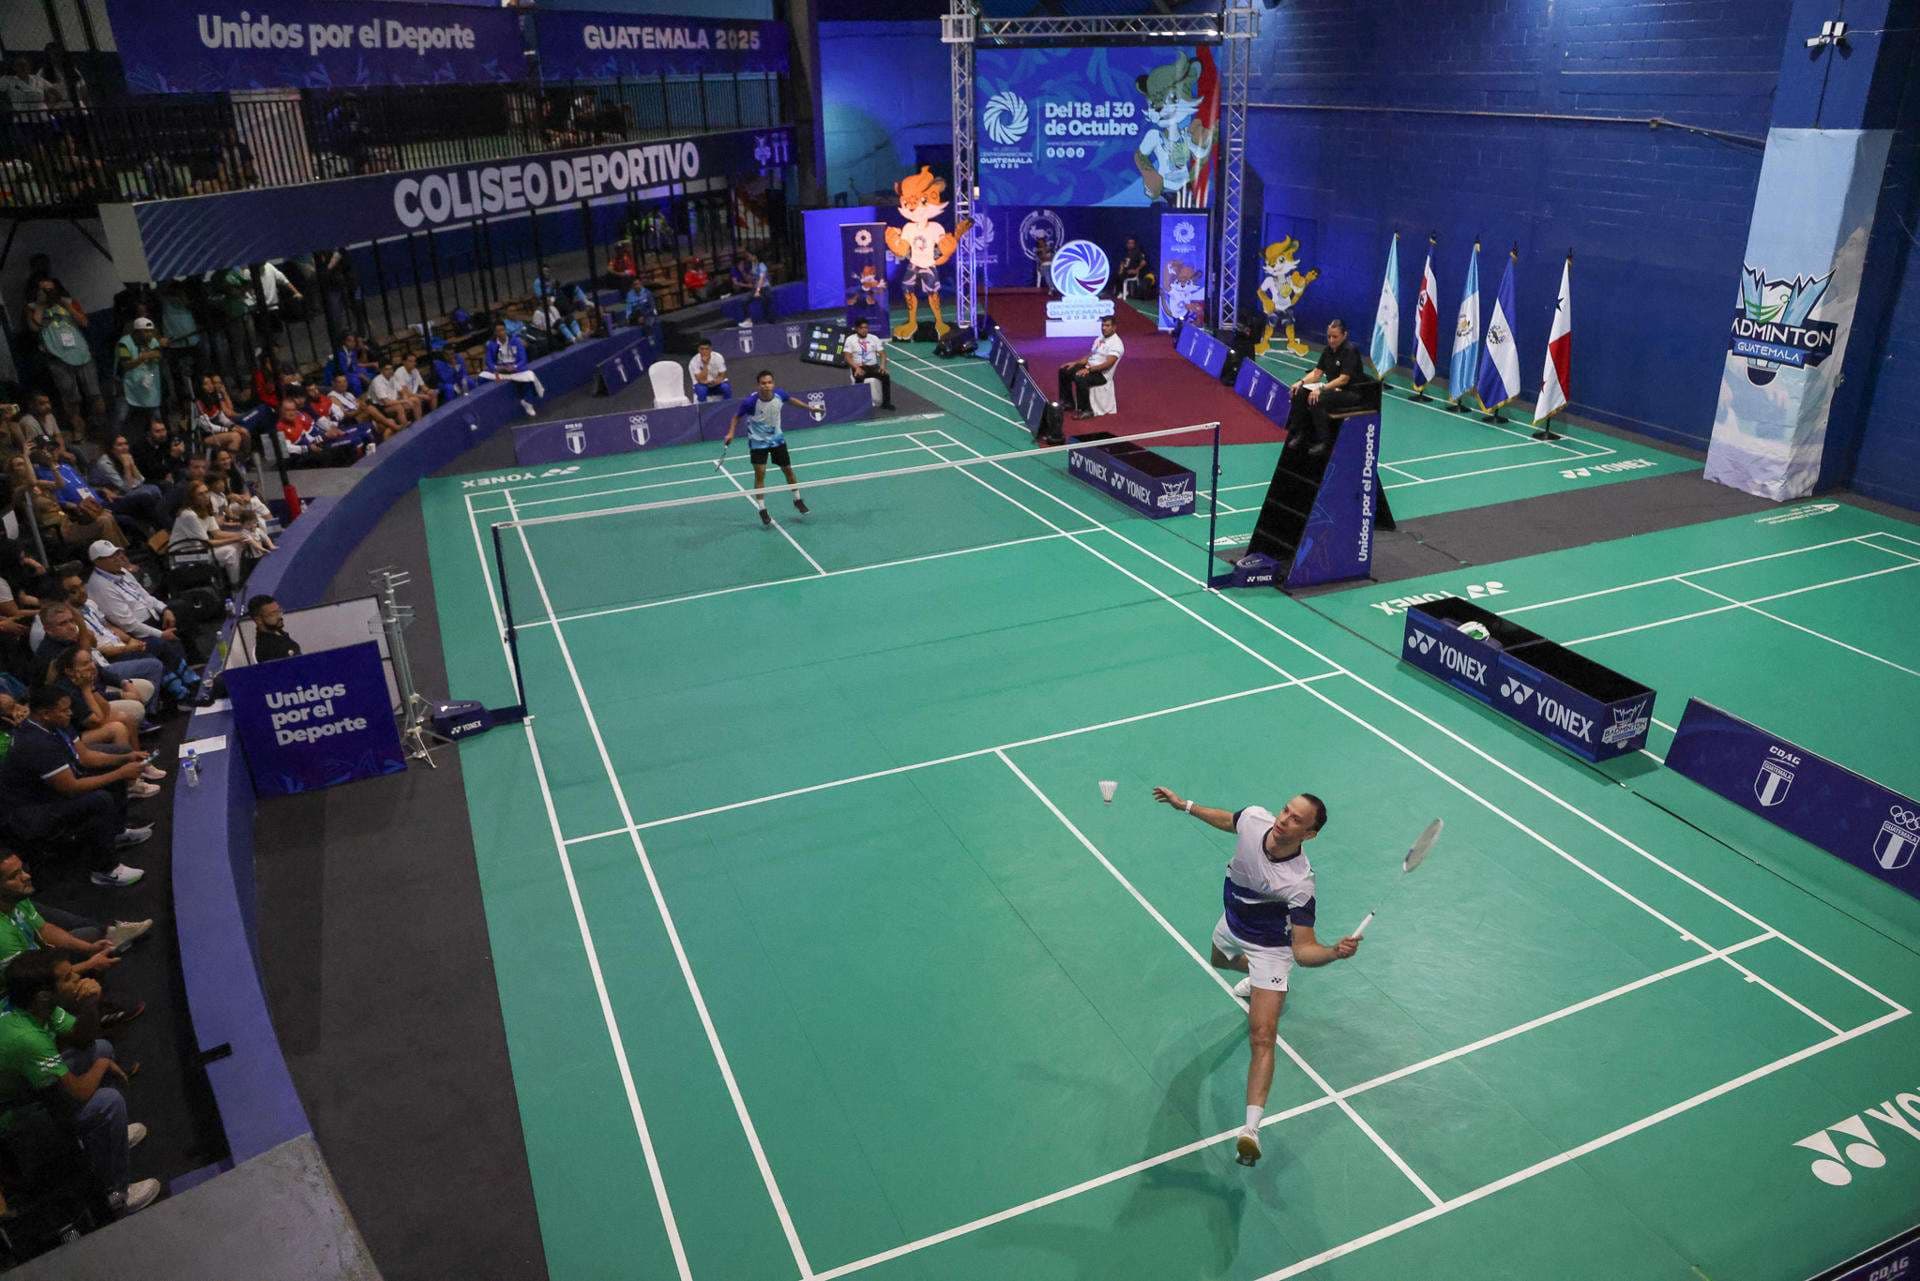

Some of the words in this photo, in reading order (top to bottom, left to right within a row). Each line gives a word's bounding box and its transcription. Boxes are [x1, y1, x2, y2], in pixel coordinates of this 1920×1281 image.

[199, 11, 303, 48] Unidos
[309, 23, 353, 55] por
[359, 19, 380, 47] el
[386, 20, 475, 55] Deporte
[583, 25, 709, 49] GUATEMALA
[715, 30, 760, 49] 2025
[1045, 102, 1072, 118] Del
[1074, 102, 1092, 118] 18
[1094, 101, 1110, 118] al
[1112, 102, 1135, 118] 30
[1045, 119, 1067, 136] de
[1068, 119, 1138, 136] Octubre
[393, 162, 548, 227] COLISEO
[551, 142, 699, 202] DEPORTIVO
[1731, 317, 1833, 347] ADMINTON
[1737, 341, 1800, 362] GUATEMALA
[1363, 423, 1375, 476] Deporte
[461, 472, 536, 488] YONEX
[1084, 458, 1107, 482] YONEX
[1126, 479, 1151, 506] YONEX
[1362, 479, 1372, 492] el
[1362, 494, 1372, 516] por
[1358, 519, 1370, 562] Unidos
[265, 683, 346, 709] Unidos
[1438, 642, 1487, 686] YONEX
[1537, 692, 1594, 743] YONEX
[272, 708, 311, 730] por
[316, 700, 334, 717] el
[275, 716, 367, 746] Deporte
[1769, 746, 1801, 765] CDAG
[1884, 822, 1918, 843] GUATEMALA
